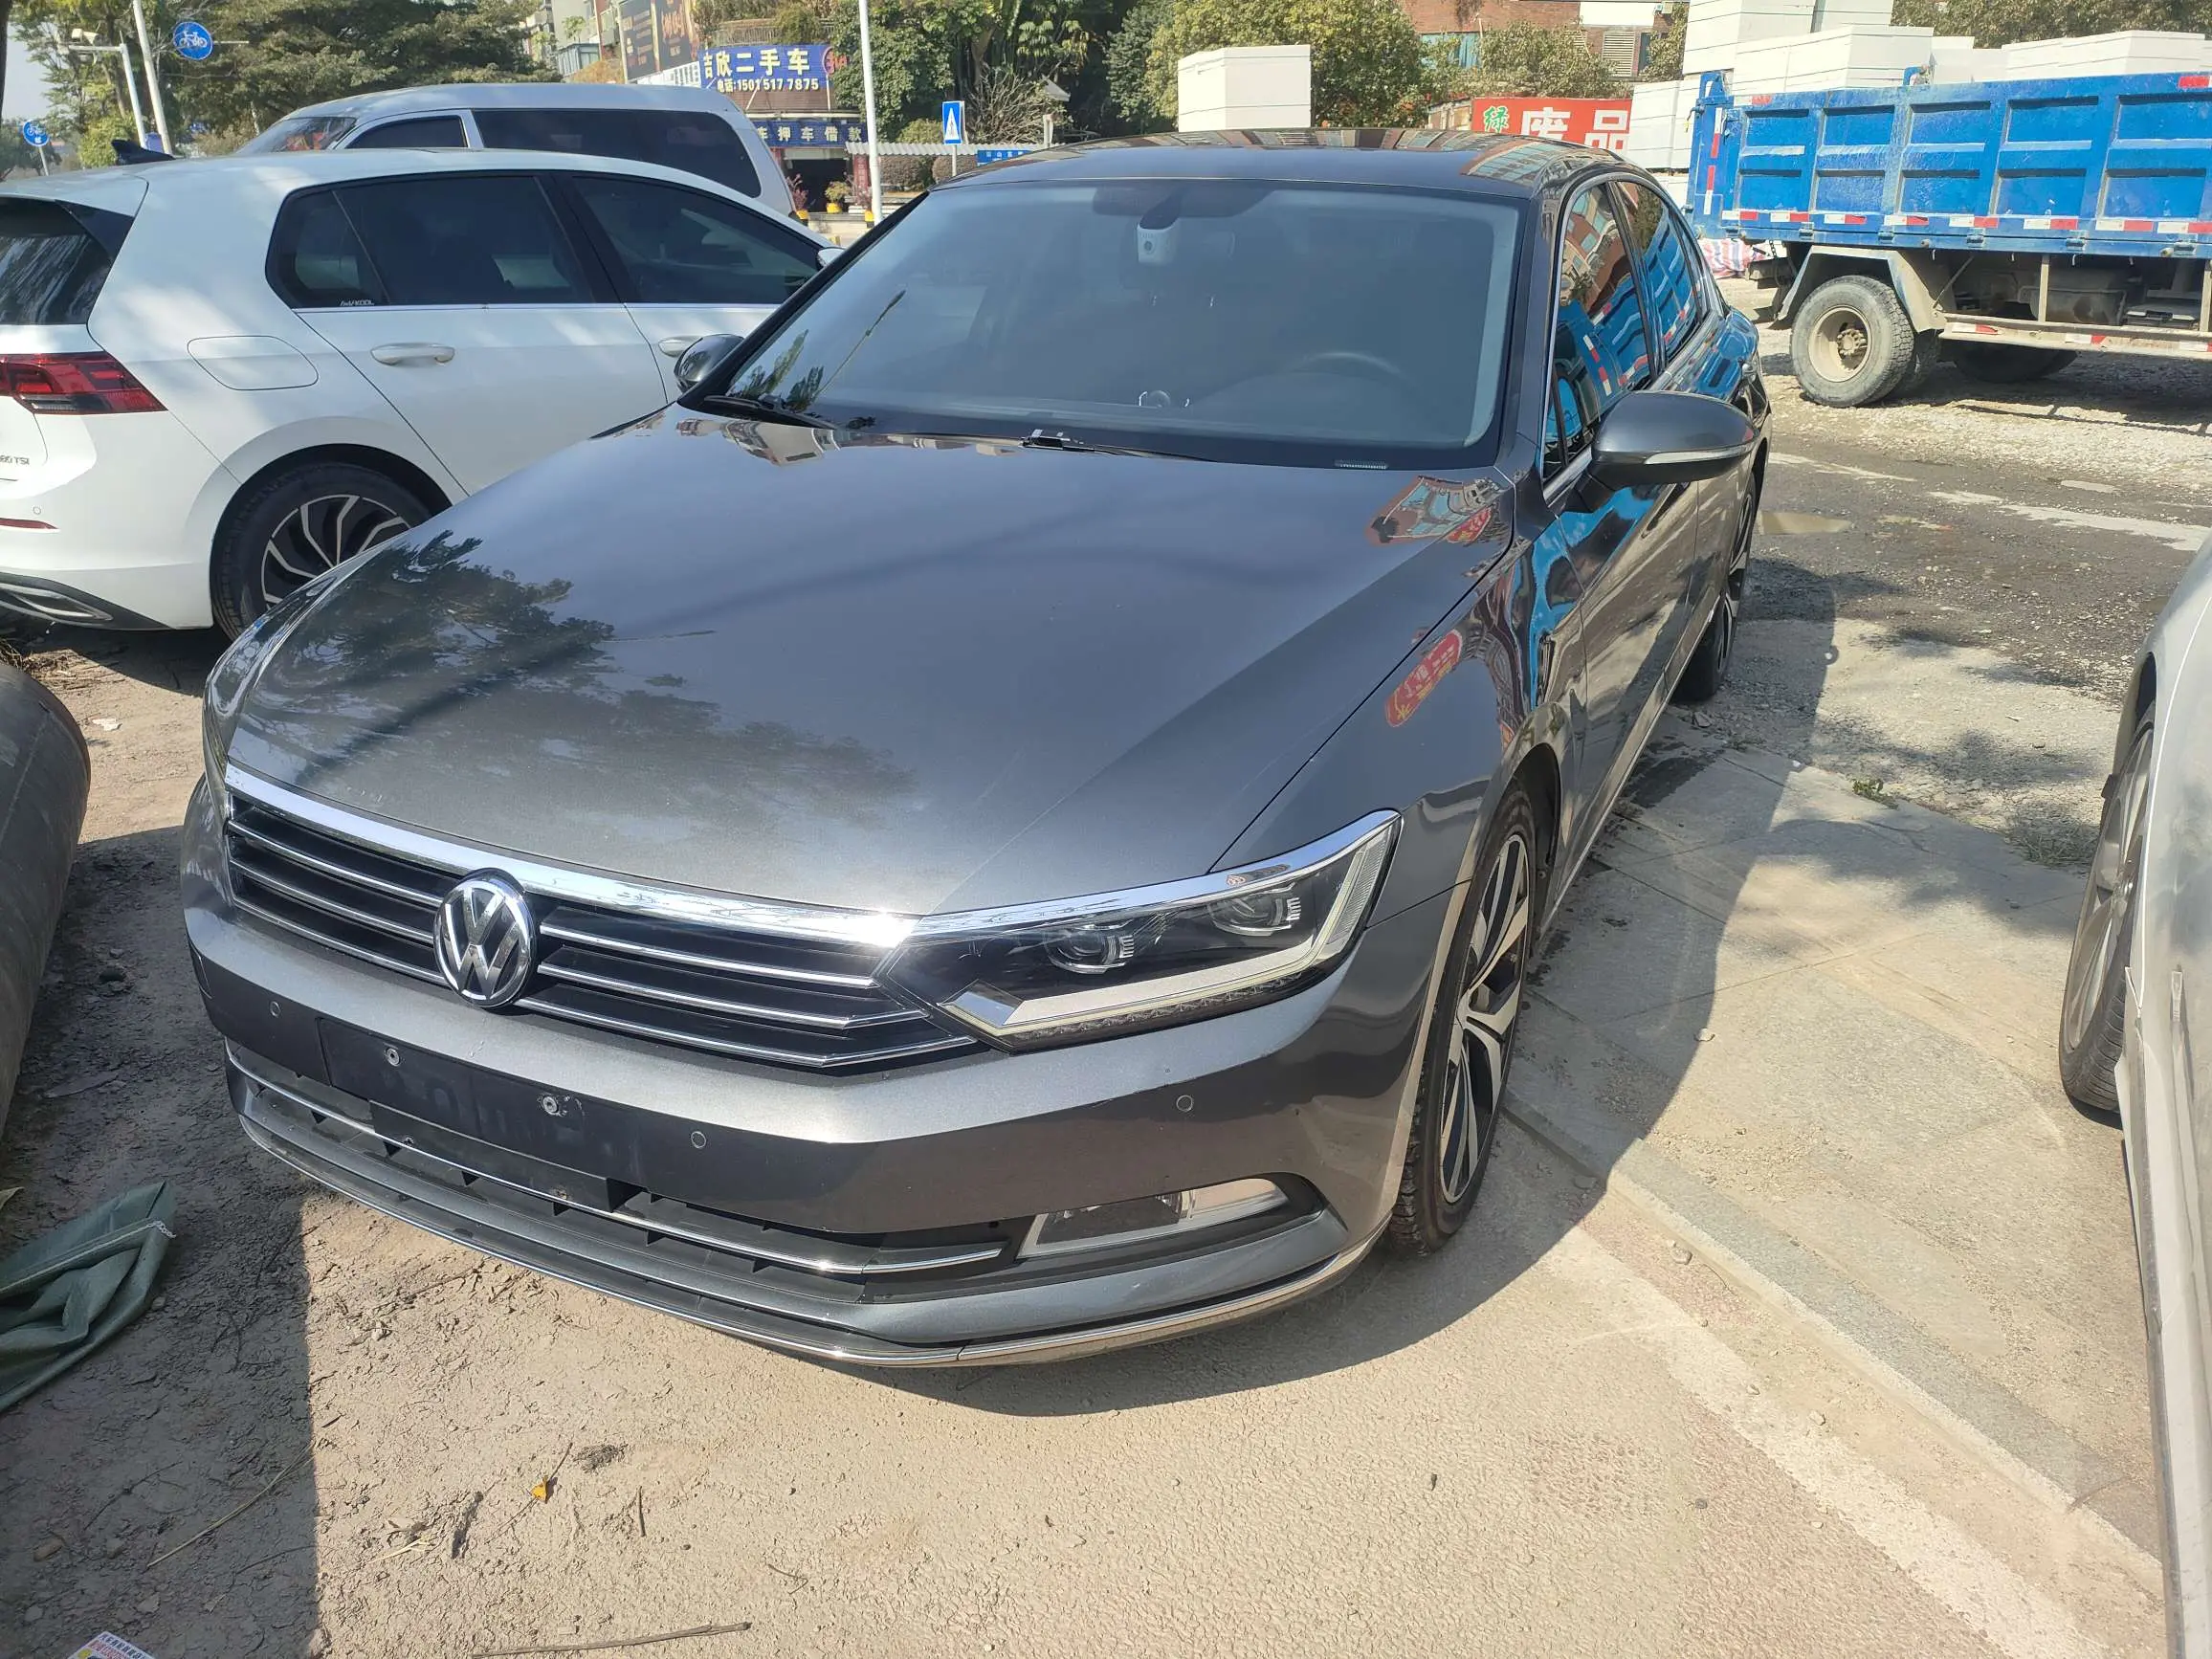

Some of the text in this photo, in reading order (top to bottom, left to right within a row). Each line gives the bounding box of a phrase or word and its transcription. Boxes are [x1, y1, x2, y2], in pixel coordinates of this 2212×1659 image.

[703, 48, 810, 78] 吉欣二手车
